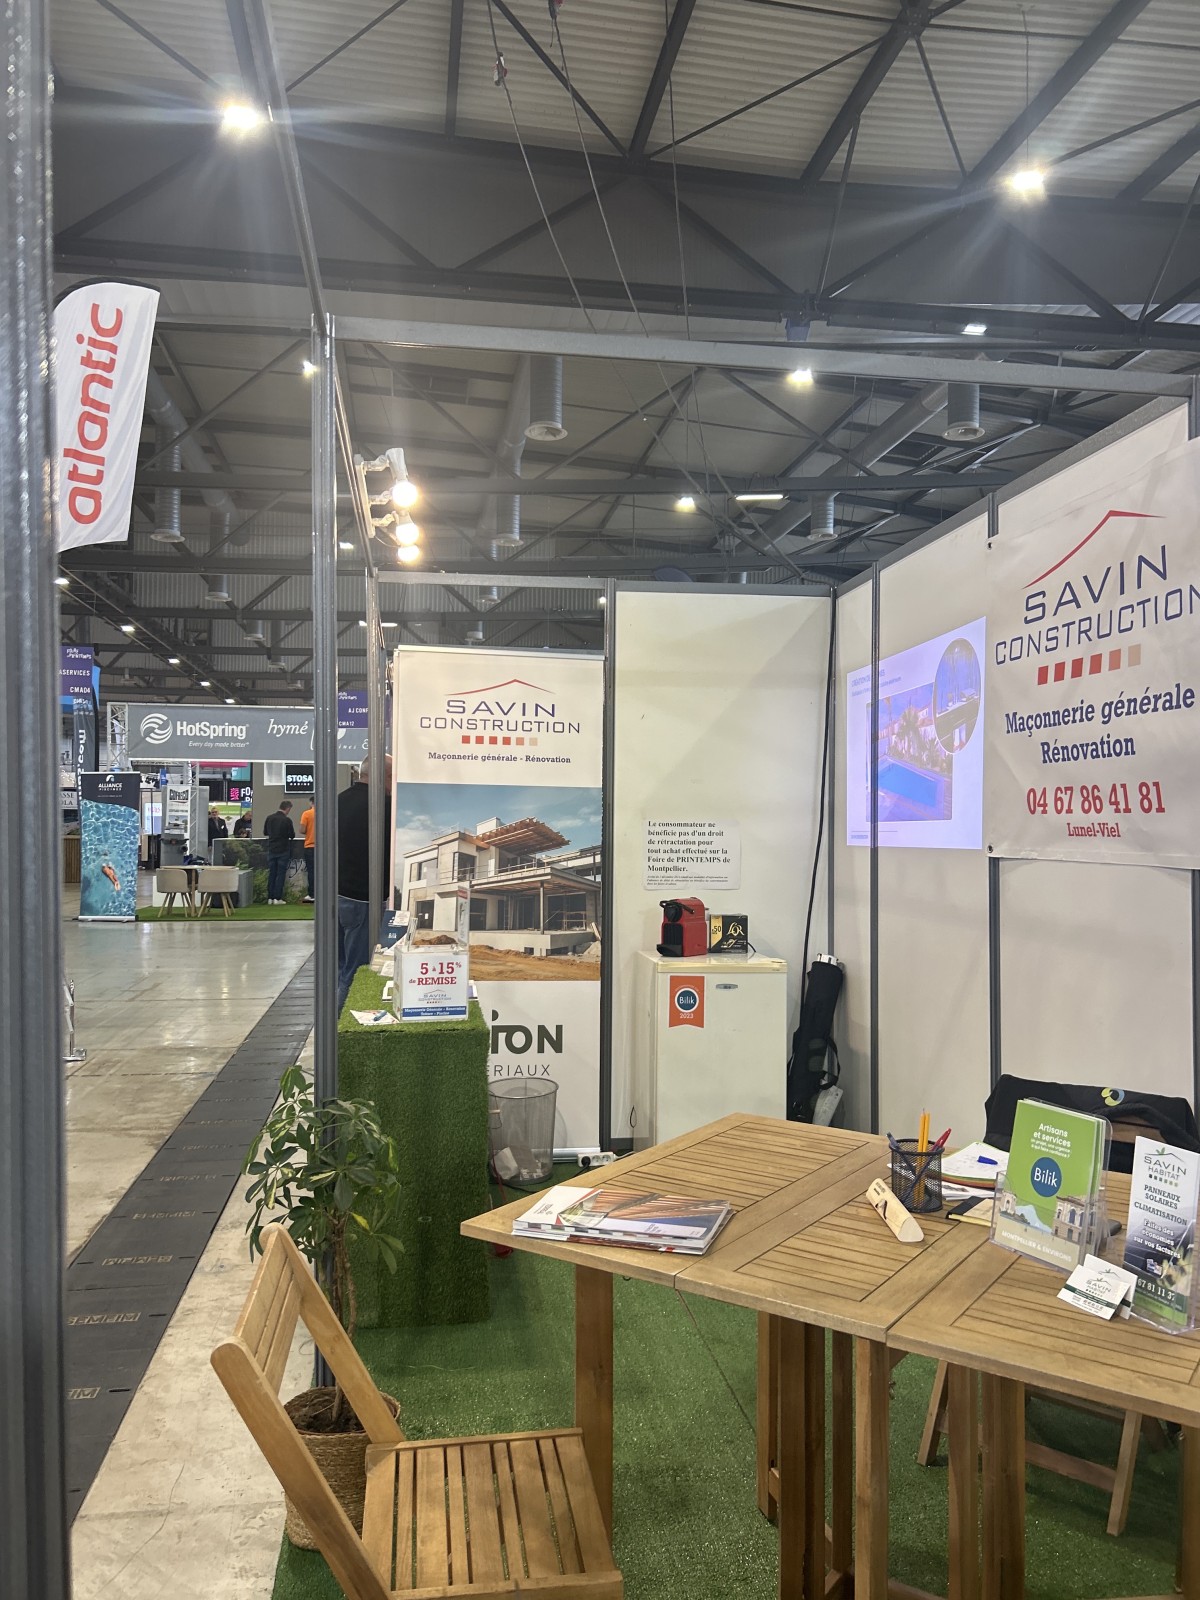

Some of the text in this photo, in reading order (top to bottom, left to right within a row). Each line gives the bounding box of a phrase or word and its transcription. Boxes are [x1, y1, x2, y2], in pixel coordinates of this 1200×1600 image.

[63, 303, 123, 524] atlantic
[1023, 545, 1167, 625] SAVIN
[995, 584, 1200, 666] CONSTRUCTION
[446, 699, 556, 718] SAVIN
[1005, 683, 1195, 737] Maçonnerie générale
[267, 719, 309, 738] hymé
[420, 716, 580, 734] CONSTRUCTION
[188, 740, 203, 748] Every
[1041, 733, 1136, 764] Rénovation
[428, 752, 479, 761] Maçonnerie
[481, 753, 518, 763] générale
[525, 755, 571, 764] Rénovation
[286, 775, 313, 783] STOSA
[1026, 781, 1166, 815] 04 67 86 41 81
[1066, 822, 1121, 838] Lunel-Viel
[647, 865, 688, 873] Montpellier.
[420, 962, 429, 975] 5
[417, 976, 457, 986] REMISE
[679, 995, 695, 1004] Bilik
[1033, 1131, 1071, 1148] et services
[1038, 1122, 1069, 1138] Artisans
[1143, 1155, 1187, 1176] SAVIN
[1147, 1165, 1180, 1181] HABITAT
[1034, 1167, 1058, 1187] Bilik
[1143, 1184, 1181, 1203] PANNEAUX
[1144, 1192, 1178, 1210] SOLAIRES
[1133, 1201, 1188, 1226] CLIMATISATION
[1141, 1227, 1175, 1246] économies
[1162, 1226, 1174, 1236] des
[1001, 1230, 1037, 1249] MONTPELLIER
[1042, 1246, 1072, 1262] ENVIRONS
[1133, 1236, 1181, 1259] sur vos factures
[1085, 1279, 1112, 1293] SAVIN
[1137, 1278, 1147, 1288] 67
[1147, 1282, 1156, 1292] 81
[1157, 1286, 1165, 1297] 11
